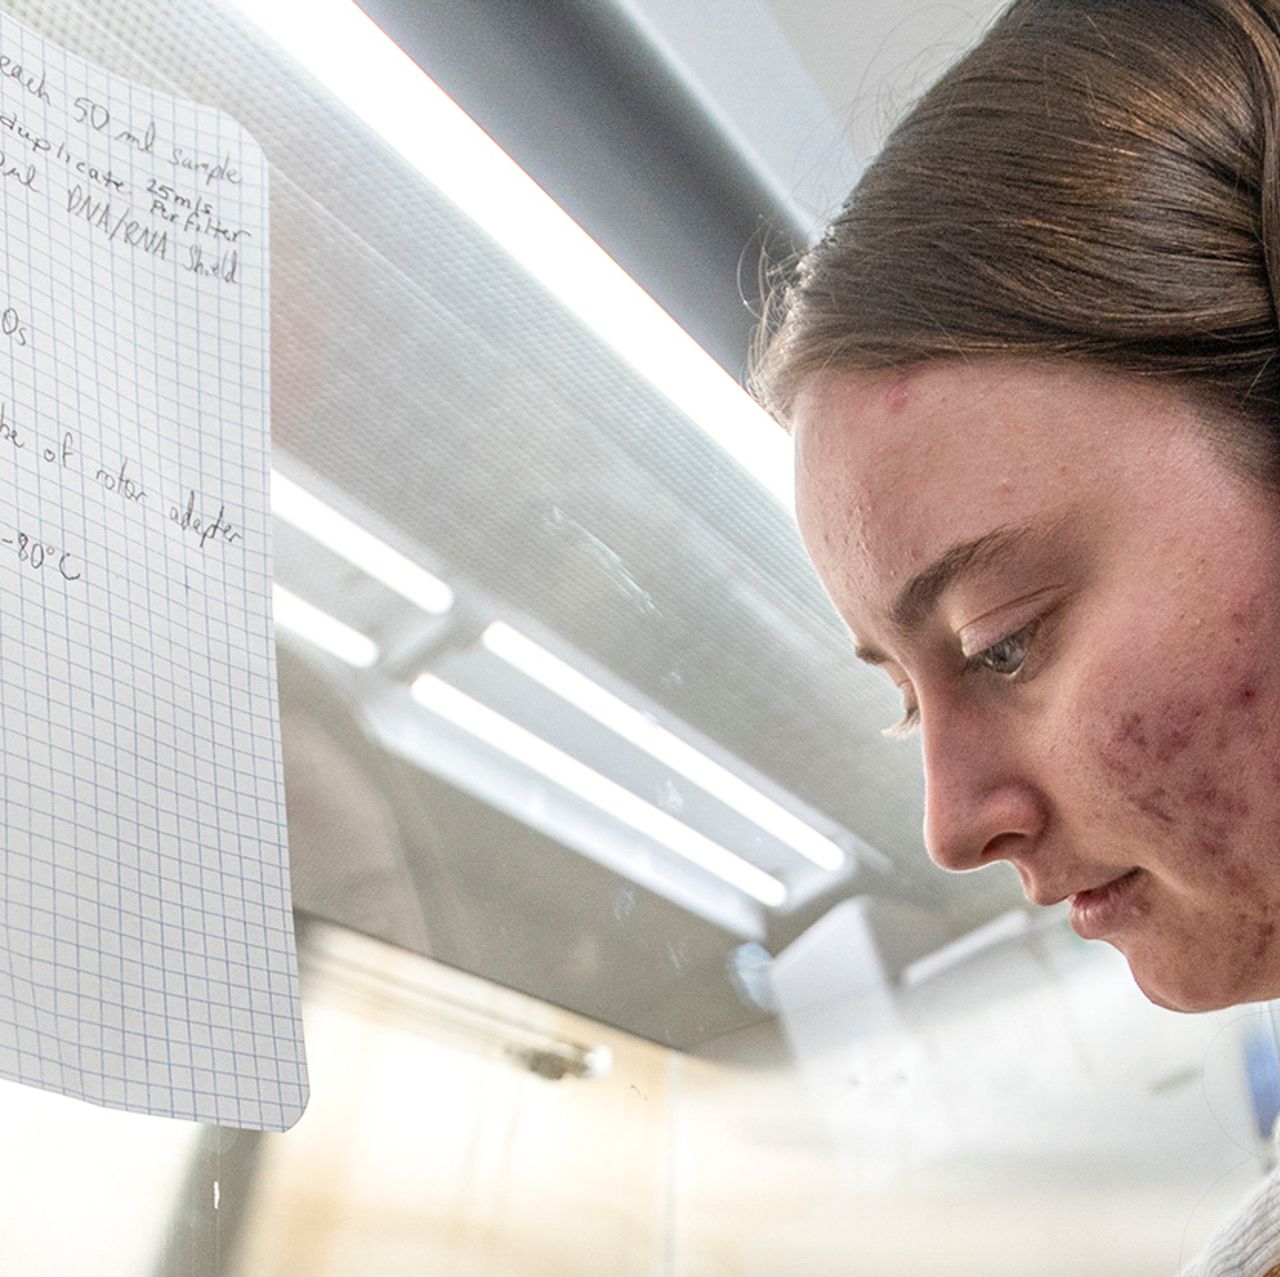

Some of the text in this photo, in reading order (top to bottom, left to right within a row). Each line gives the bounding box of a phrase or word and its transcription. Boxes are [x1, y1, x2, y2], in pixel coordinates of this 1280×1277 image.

[73, 97, 110, 131] 50
[66, 184, 168, 261] DNA/RNA
[43, 431, 74, 468] of
[95, 456, 149, 502] rotor
